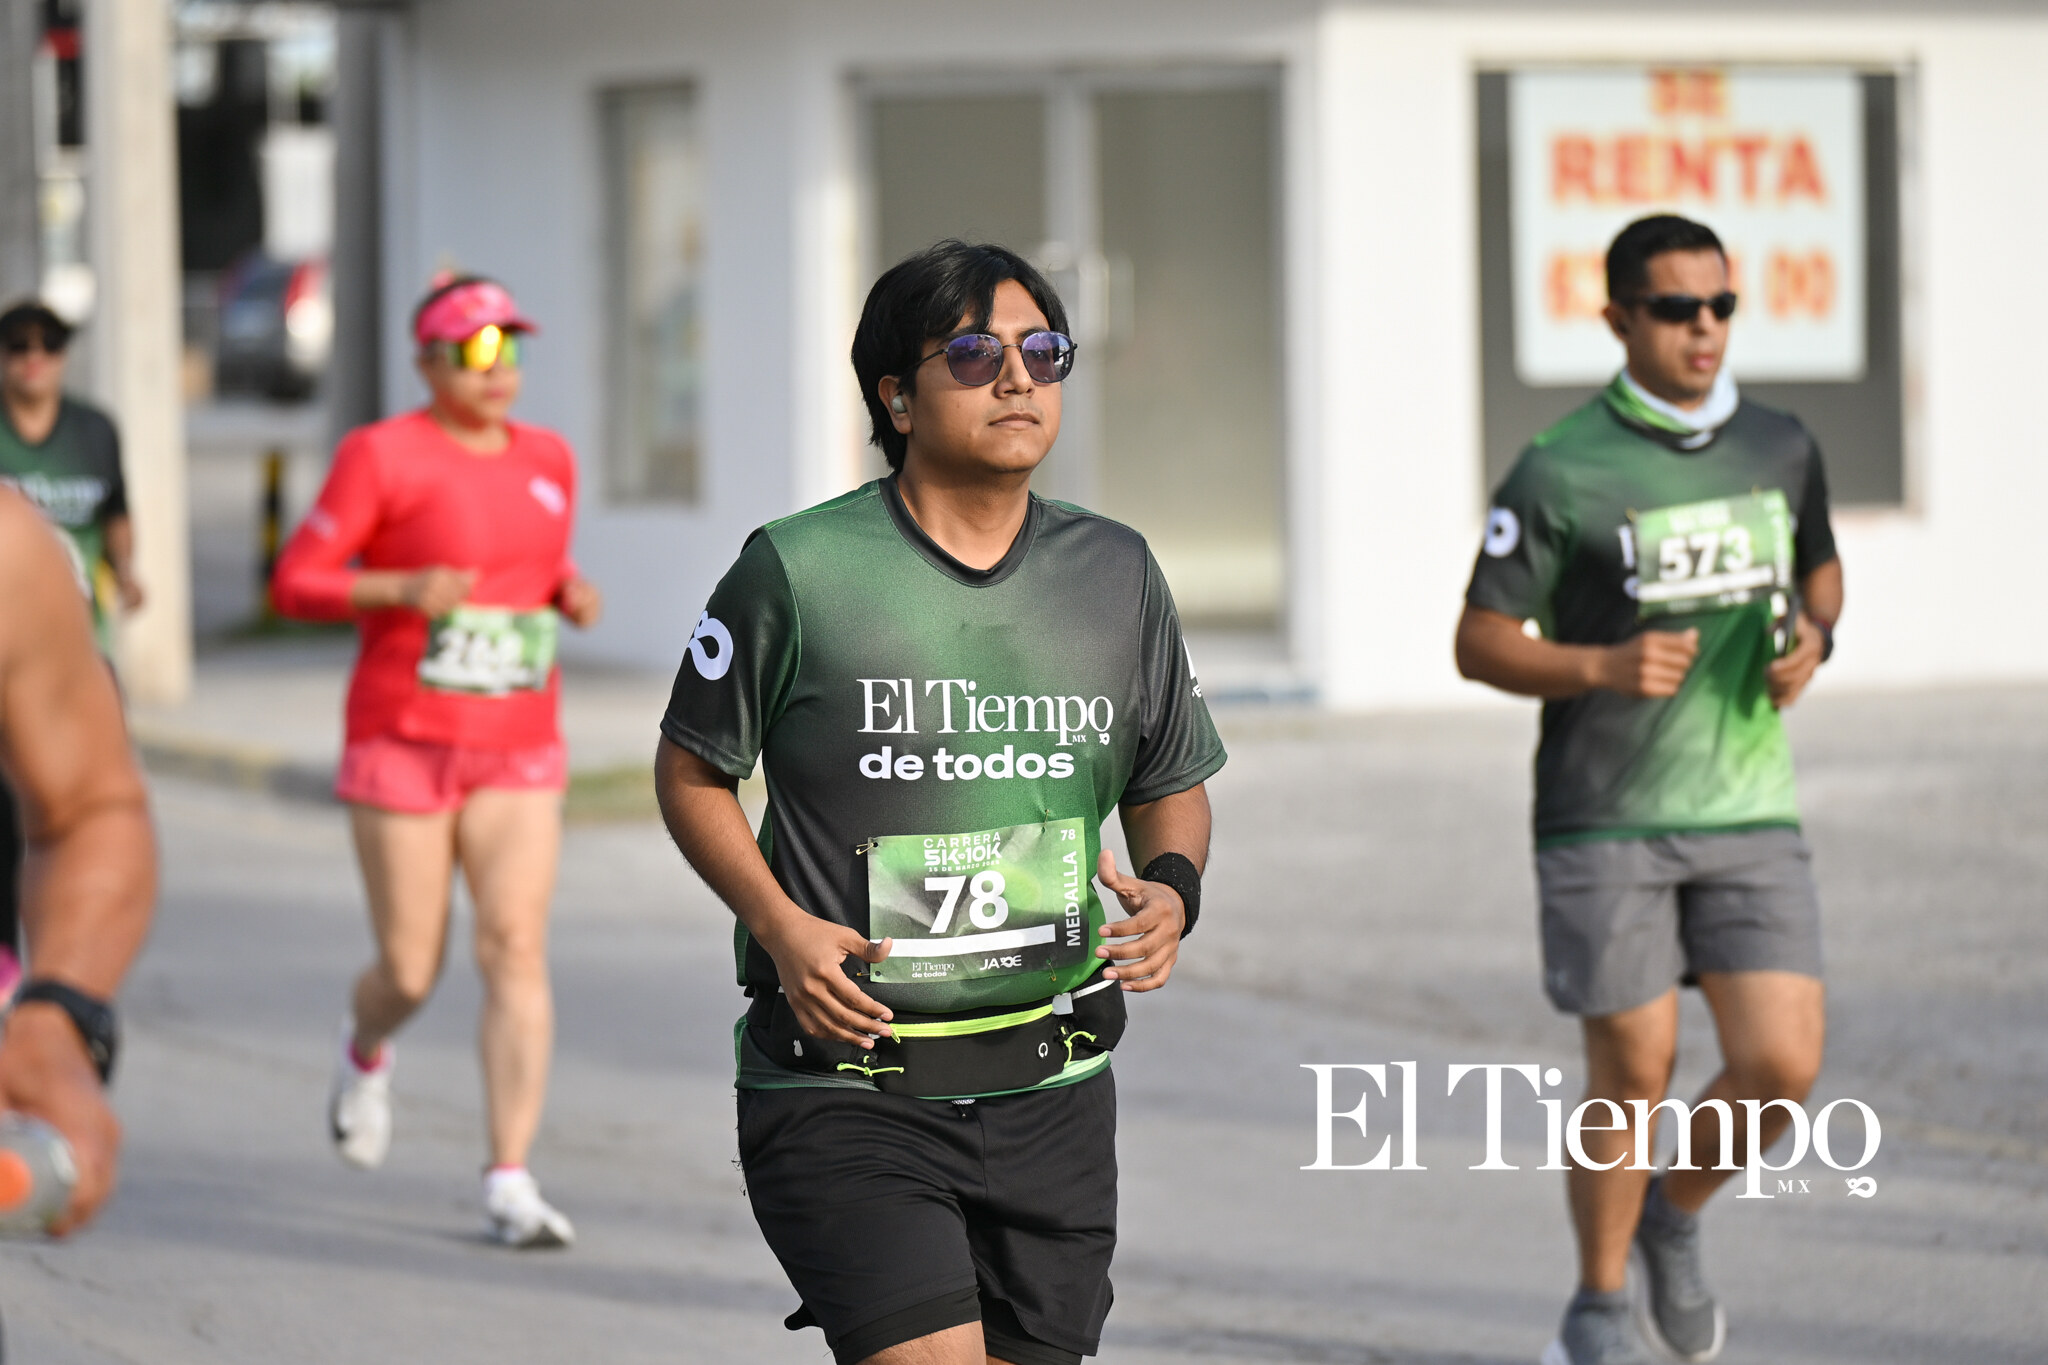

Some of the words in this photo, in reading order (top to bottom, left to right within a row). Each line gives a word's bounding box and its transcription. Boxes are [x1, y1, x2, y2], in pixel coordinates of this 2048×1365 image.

[1549, 132, 1828, 203] RENTA
[1658, 526, 1752, 582] 573
[856, 678, 919, 734] El
[925, 678, 1114, 746] Tiempo
[1072, 734, 1087, 744] MX
[859, 746, 925, 780] de
[932, 745, 1075, 781] todos
[923, 831, 1001, 849] CARRERA
[1060, 828, 1076, 841] 78
[955, 863, 980, 871] MARZO
[924, 870, 1009, 934] 78
[1062, 850, 1081, 947] MEDALLA
[912, 962, 922, 971] El
[922, 961, 955, 972] Tiempo
